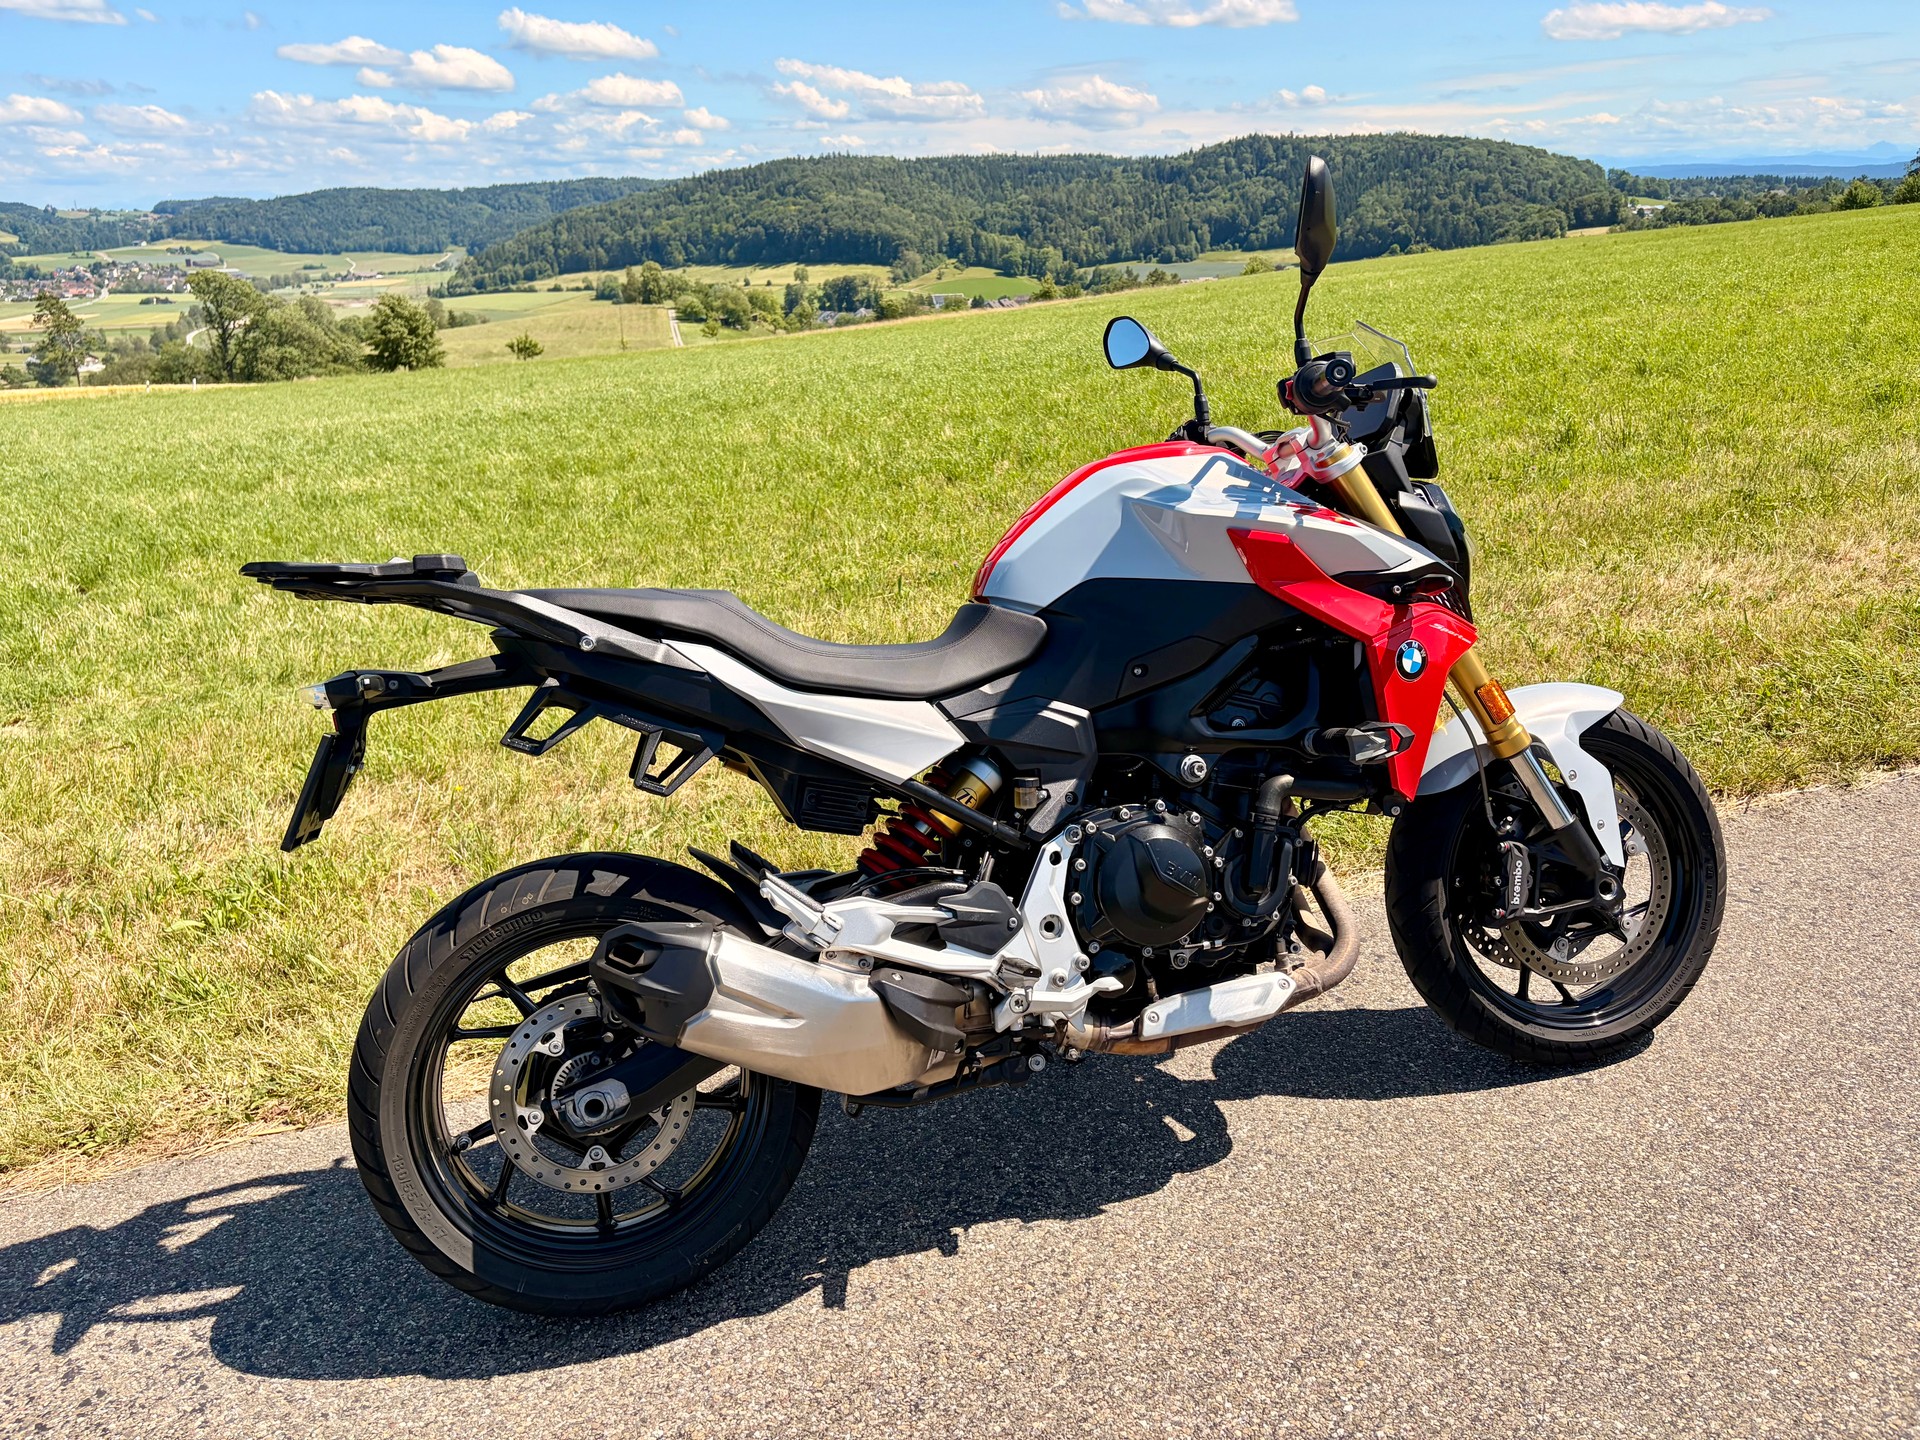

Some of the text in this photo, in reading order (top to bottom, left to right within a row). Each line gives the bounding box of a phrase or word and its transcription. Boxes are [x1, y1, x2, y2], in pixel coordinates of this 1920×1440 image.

[1401, 640, 1426, 658] BMW
[956, 788, 977, 807] ZF
[1510, 860, 1523, 905] brembo
[391, 1153, 418, 1202] 180/55
[430, 1223, 449, 1240] 17
